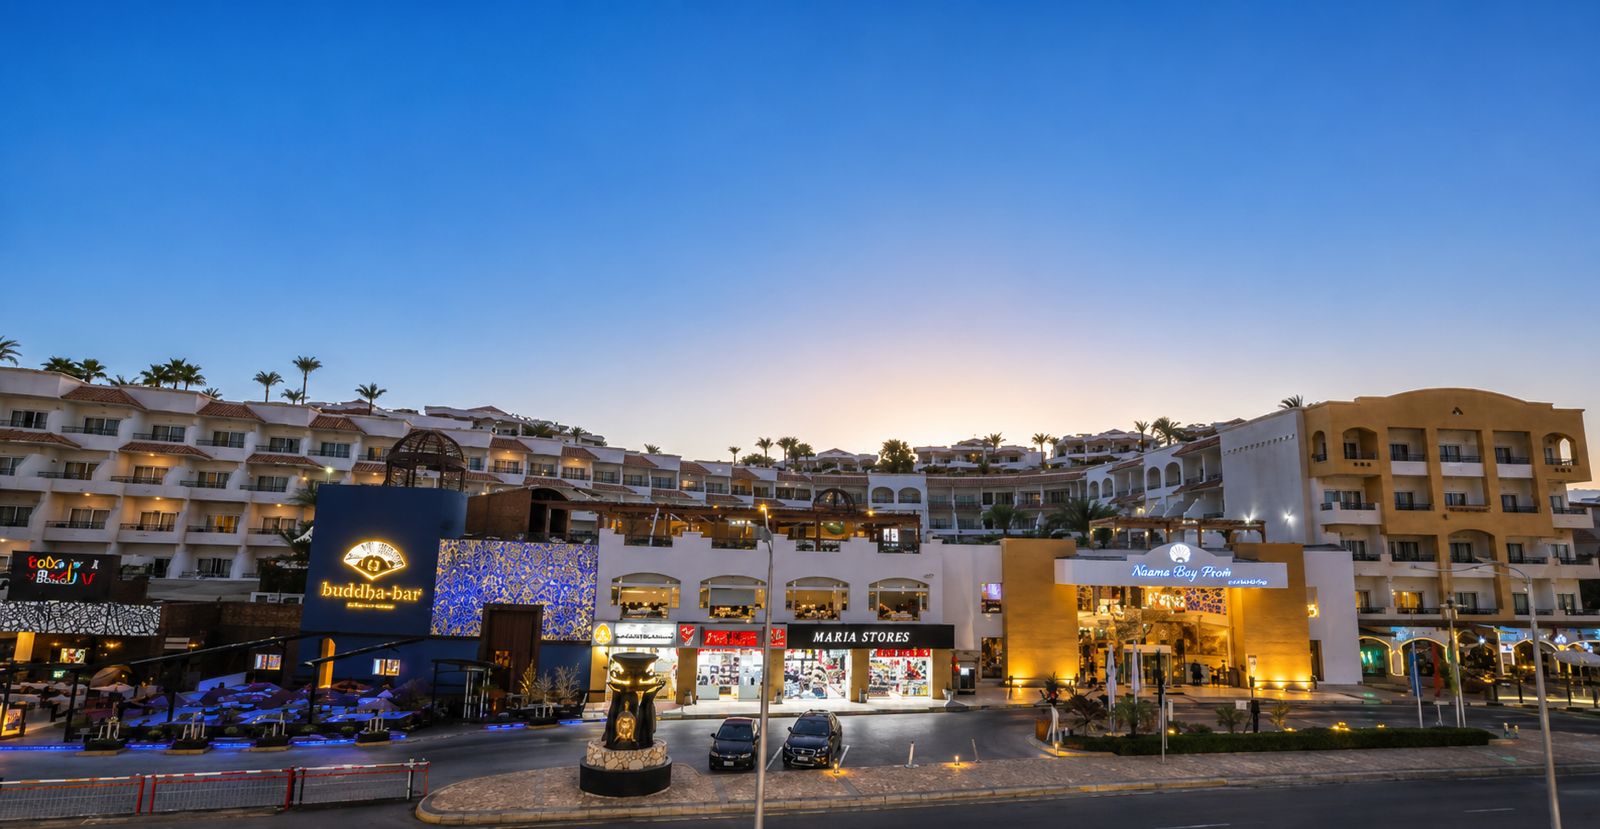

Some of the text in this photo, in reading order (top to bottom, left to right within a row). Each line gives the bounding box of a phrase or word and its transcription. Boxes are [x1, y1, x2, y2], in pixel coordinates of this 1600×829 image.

[321, 581, 422, 600] buddha-bar
[812, 631, 910, 643] MARIA STORES
